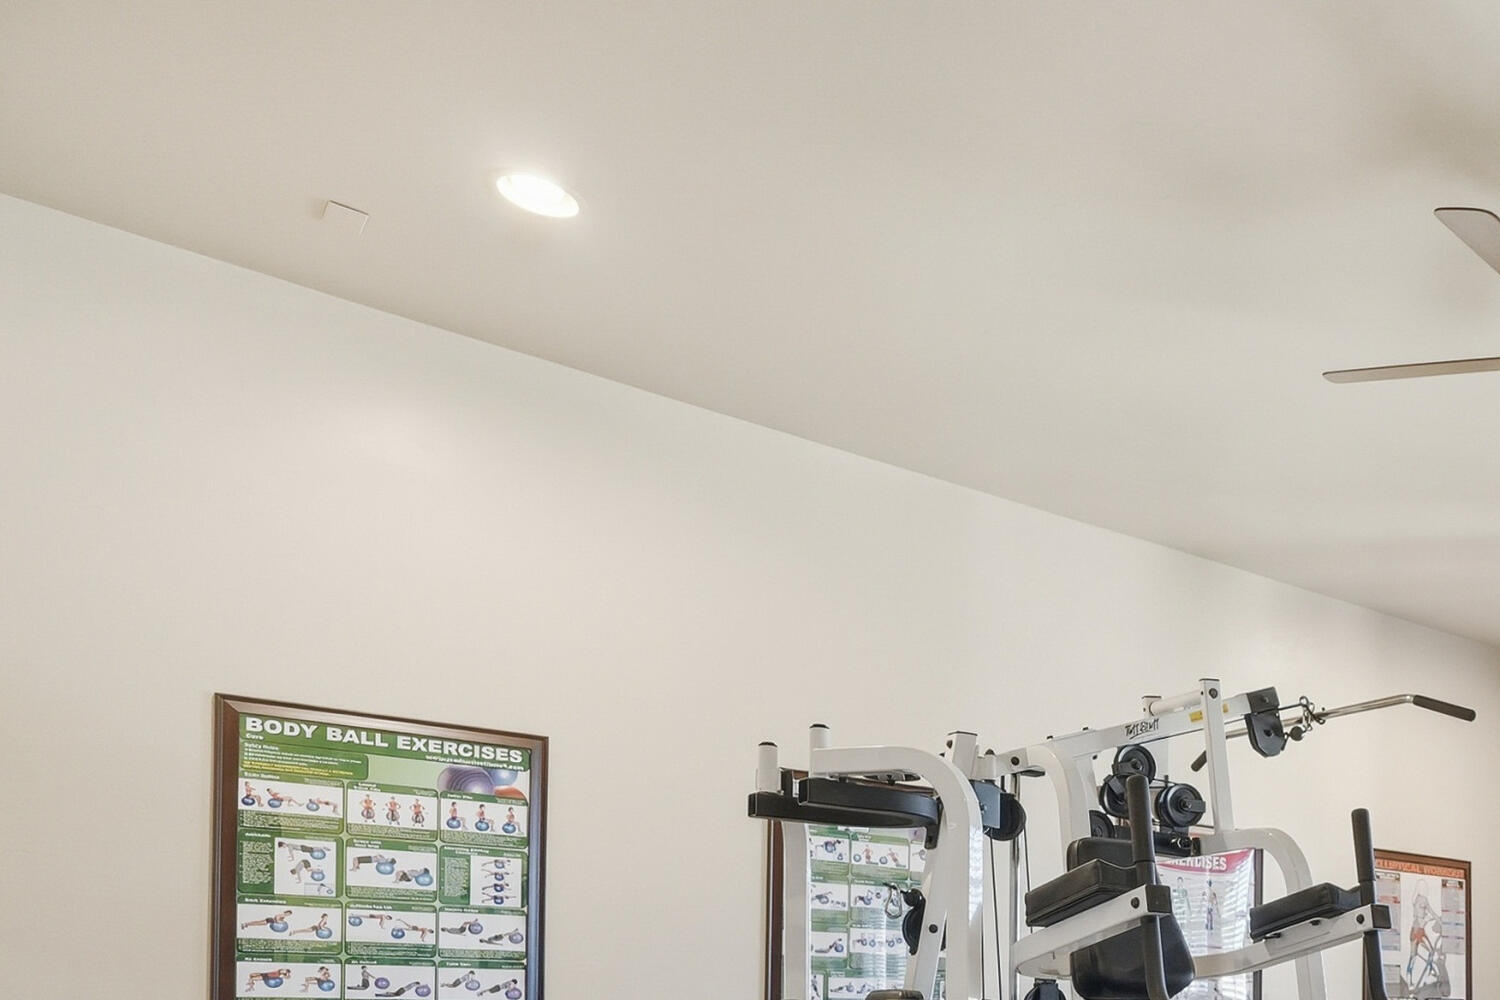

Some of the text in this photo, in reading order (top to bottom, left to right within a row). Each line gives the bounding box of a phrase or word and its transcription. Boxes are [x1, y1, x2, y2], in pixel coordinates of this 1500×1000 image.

[245, 717, 523, 763] BODY BALL EXERCISES
